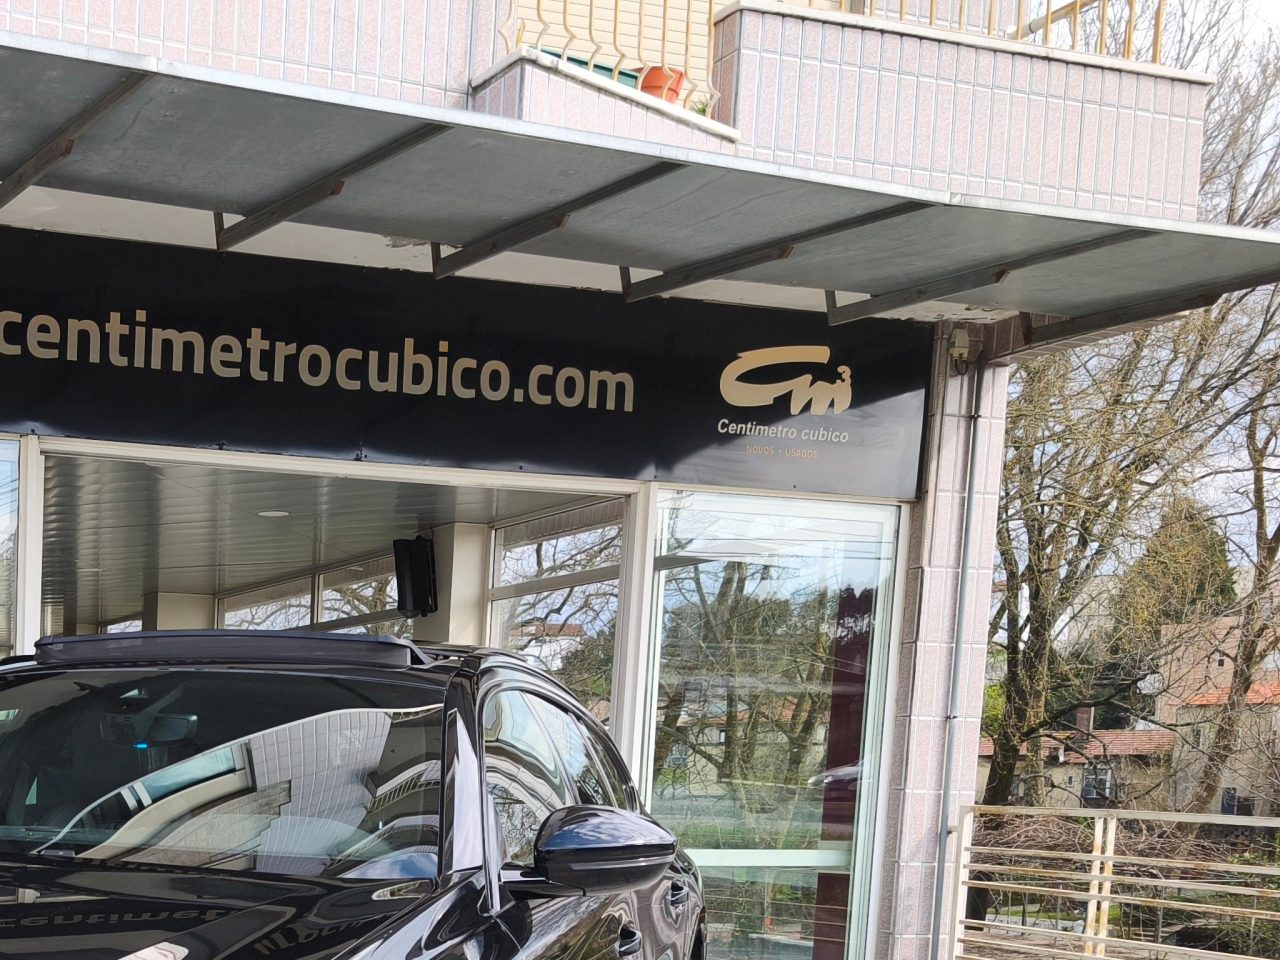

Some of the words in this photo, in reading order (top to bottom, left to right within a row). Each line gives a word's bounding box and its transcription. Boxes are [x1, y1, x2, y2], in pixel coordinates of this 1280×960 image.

[717, 418, 797, 439] Centimetro
[801, 427, 849, 443] cubico
[746, 445, 774, 455] NOVOS
[785, 449, 818, 459] USADOS
